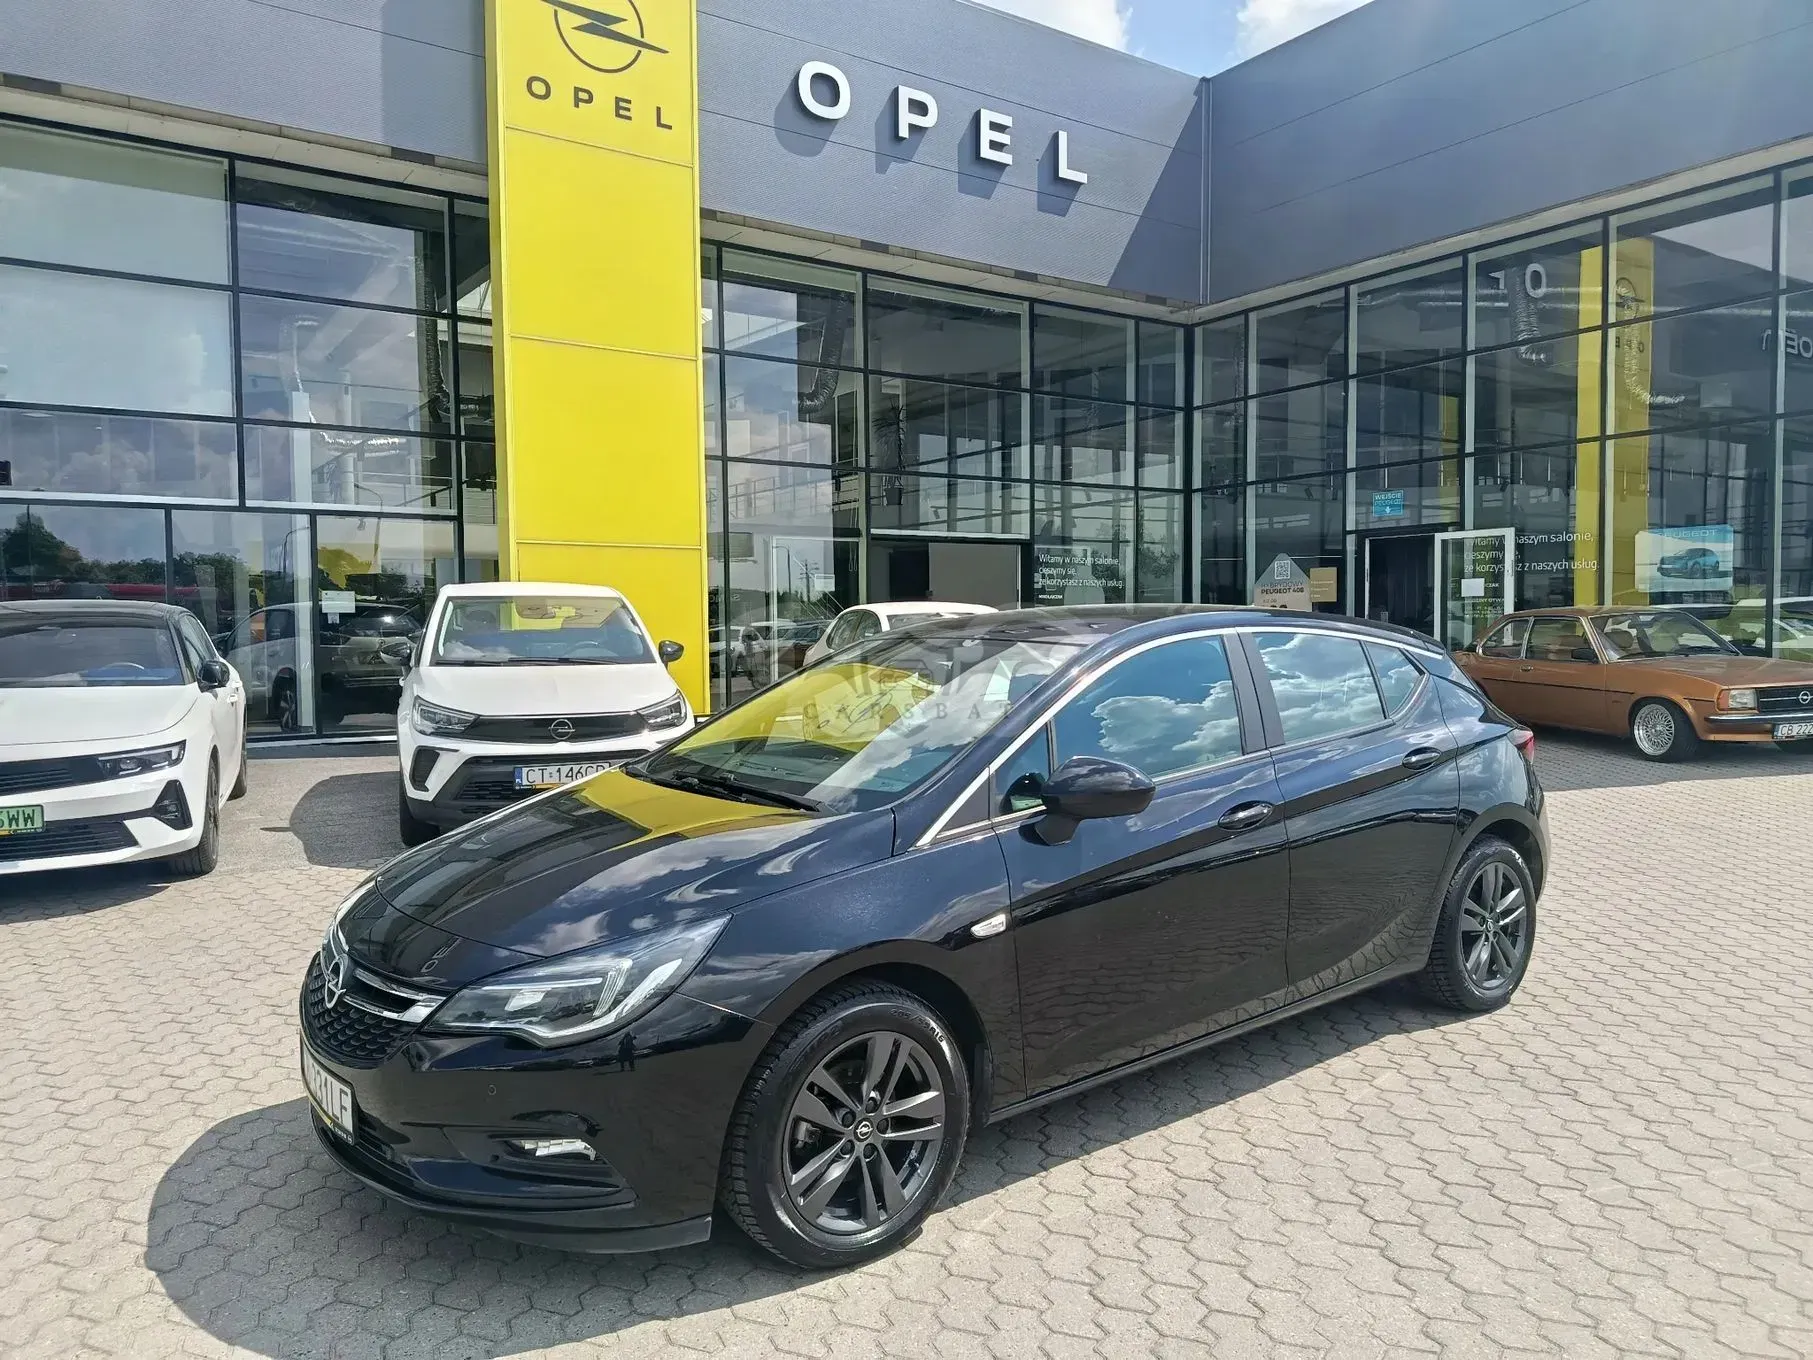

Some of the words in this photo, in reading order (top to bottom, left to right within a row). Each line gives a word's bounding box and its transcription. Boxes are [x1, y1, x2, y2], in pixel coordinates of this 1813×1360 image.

[526, 75, 673, 131] OPEL
[798, 60, 1088, 185] OPEL
[1550, 531, 1594, 543] salonie,
[1039, 554, 1063, 565] Witamy
[1476, 561, 1522, 574] korzysz
[1524, 563, 1529, 571] z
[1532, 559, 1569, 572] naszych
[1781, 725, 1794, 736] CB
[526, 768, 547, 784] CT
